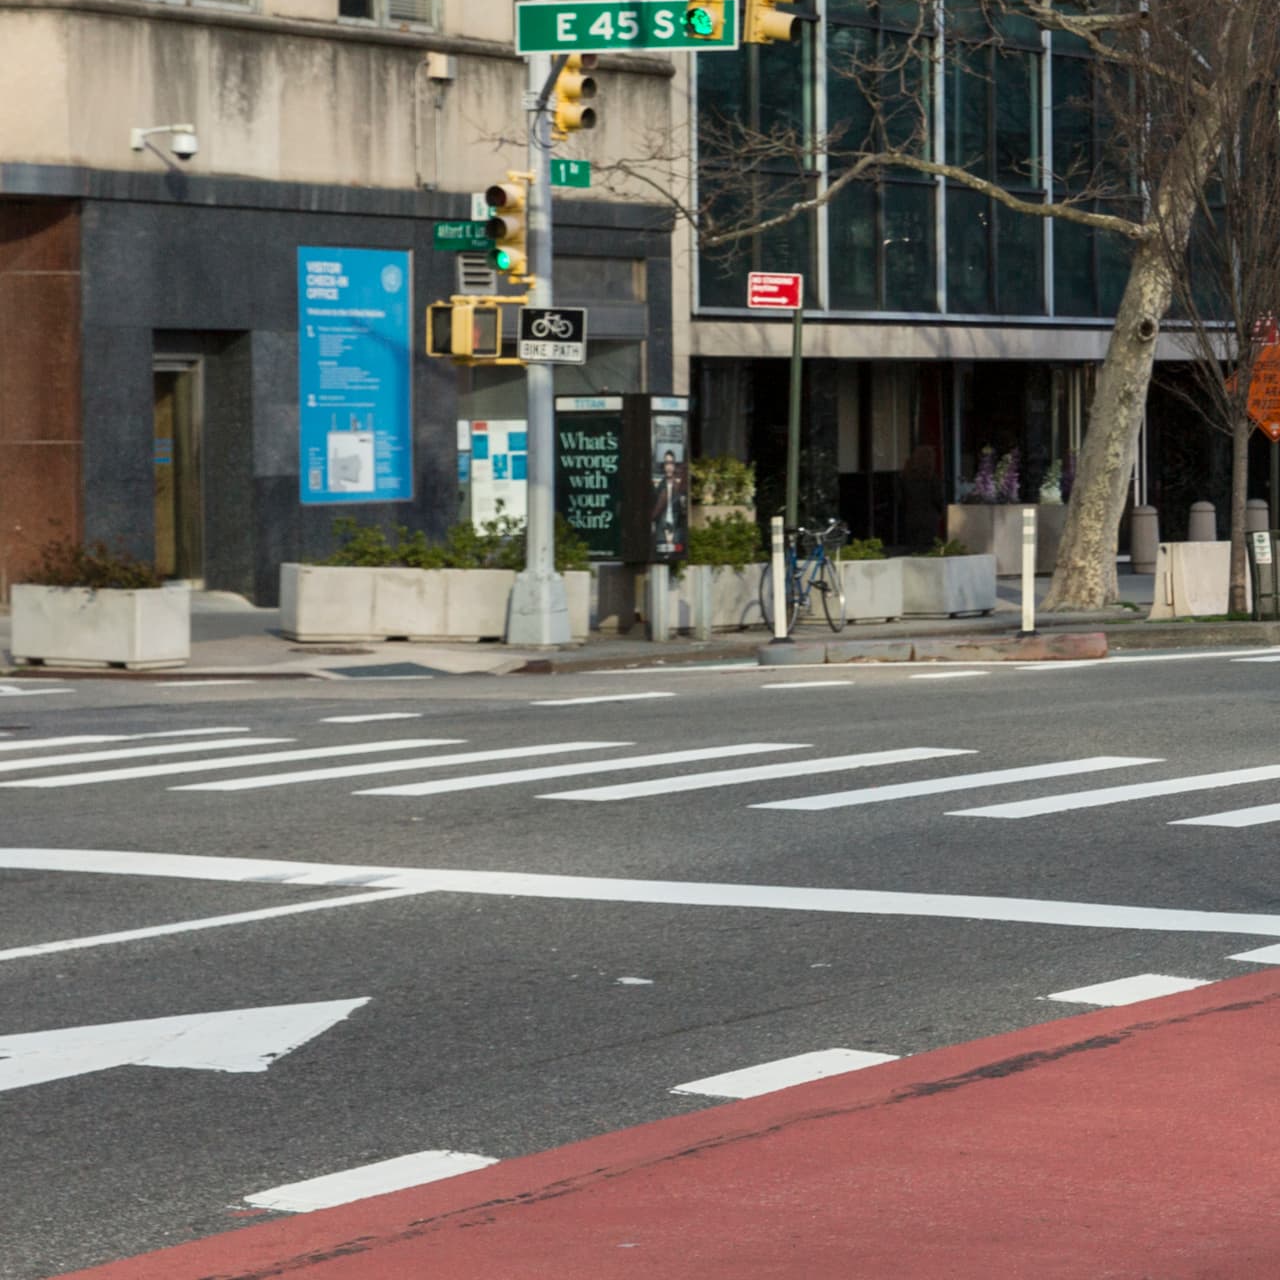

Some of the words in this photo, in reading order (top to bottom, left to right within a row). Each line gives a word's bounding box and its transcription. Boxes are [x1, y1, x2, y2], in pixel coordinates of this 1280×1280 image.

[557, 13, 577, 41] E
[589, 11, 639, 40] 45
[654, 10, 681, 39] S
[523, 343, 546, 356] BIKE
[552, 343, 580, 356] PATH
[574, 399, 606, 408] TITAN
[560, 431, 618, 451] What's
[560, 454, 618, 472] wrong
[569, 472, 608, 488] with
[568, 493, 610, 512] your
[567, 510, 613, 529] skin?
